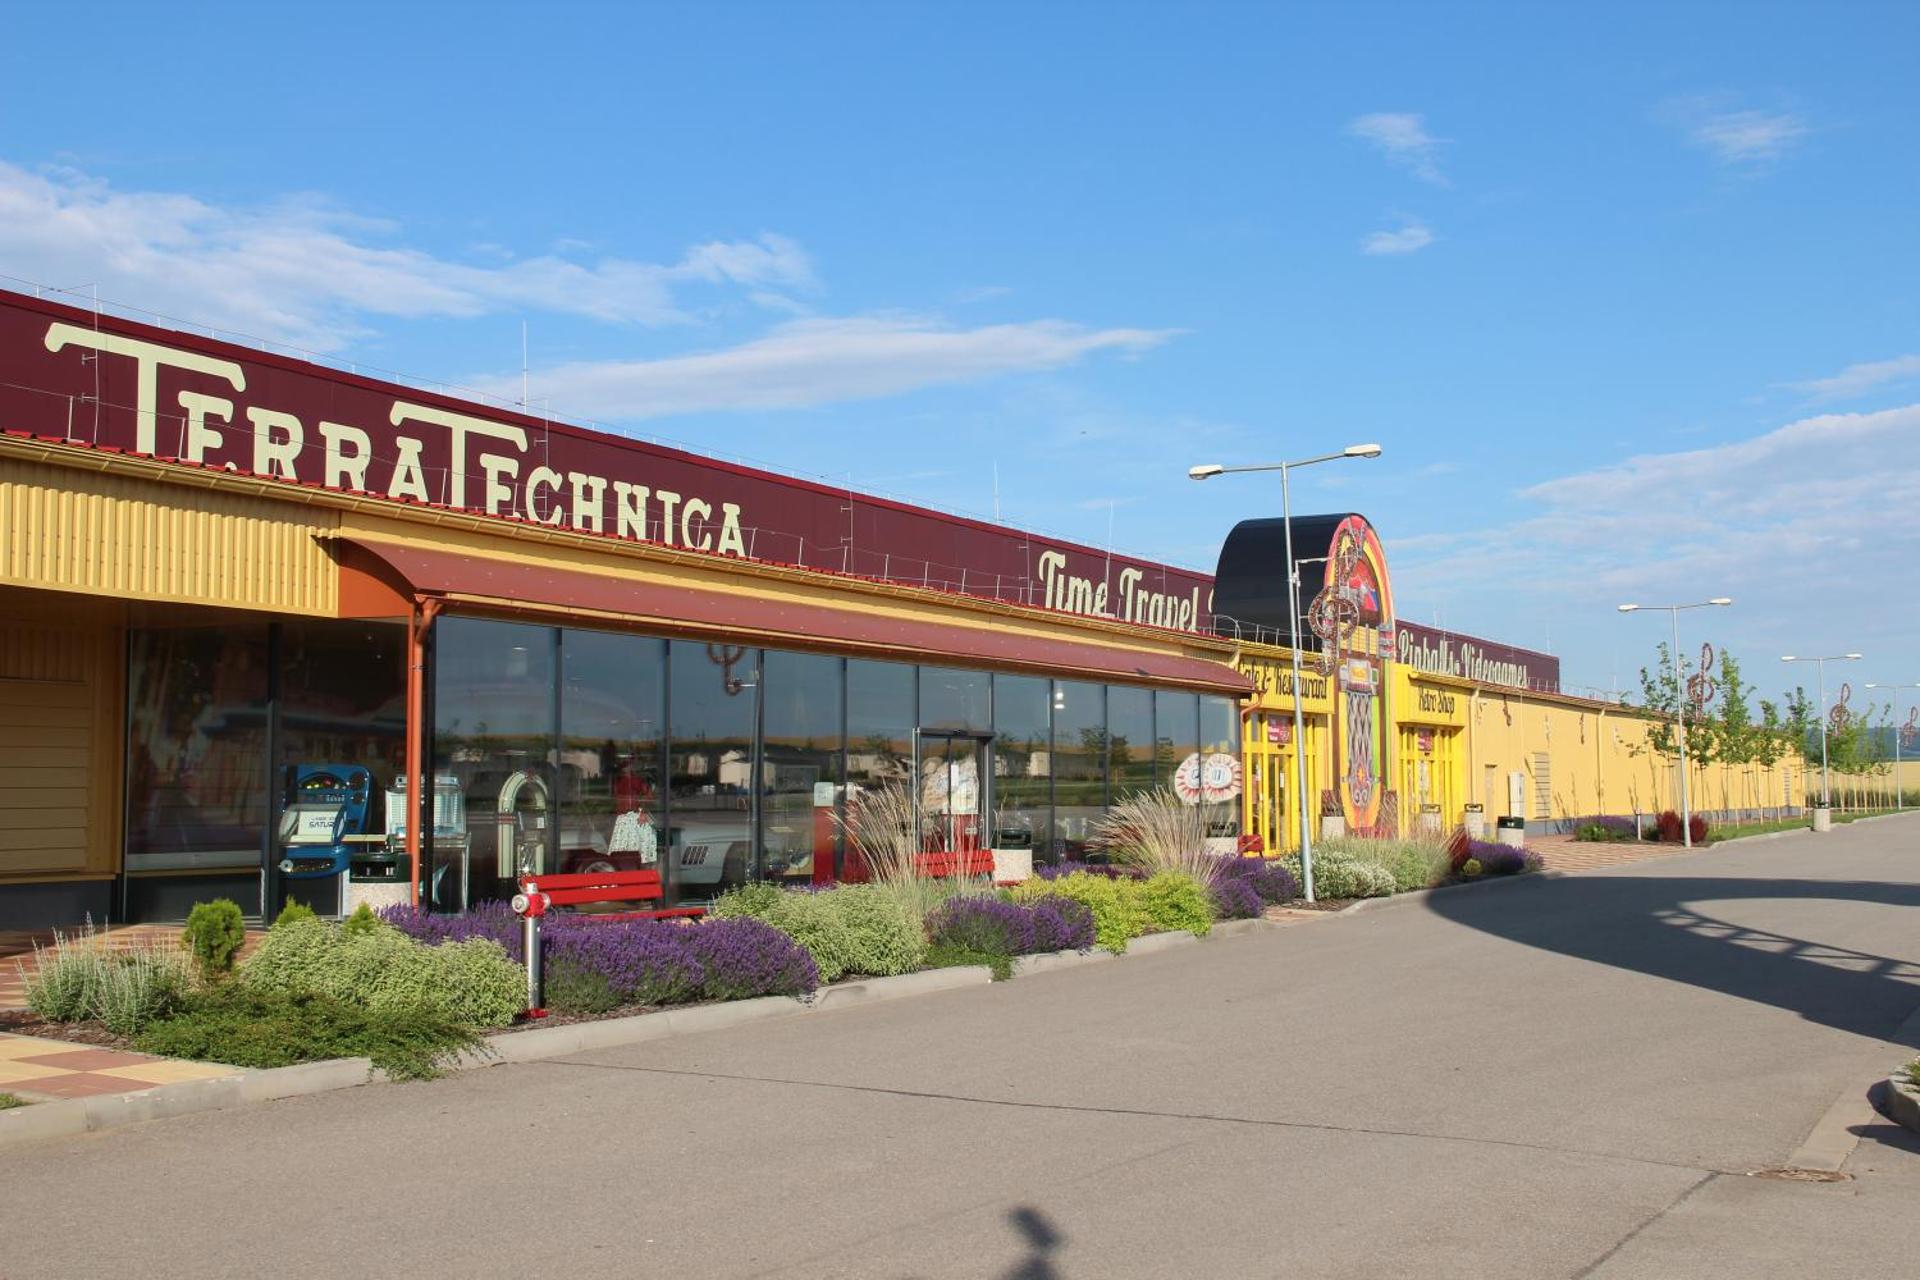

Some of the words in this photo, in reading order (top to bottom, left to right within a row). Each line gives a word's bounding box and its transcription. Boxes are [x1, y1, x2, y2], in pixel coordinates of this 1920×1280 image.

[1039, 550, 1110, 618] Time
[1120, 567, 1199, 633] Travel
[1398, 629, 1455, 676] Pinballs
[1419, 684, 1437, 713] Retro
[1438, 687, 1455, 722] Shop
